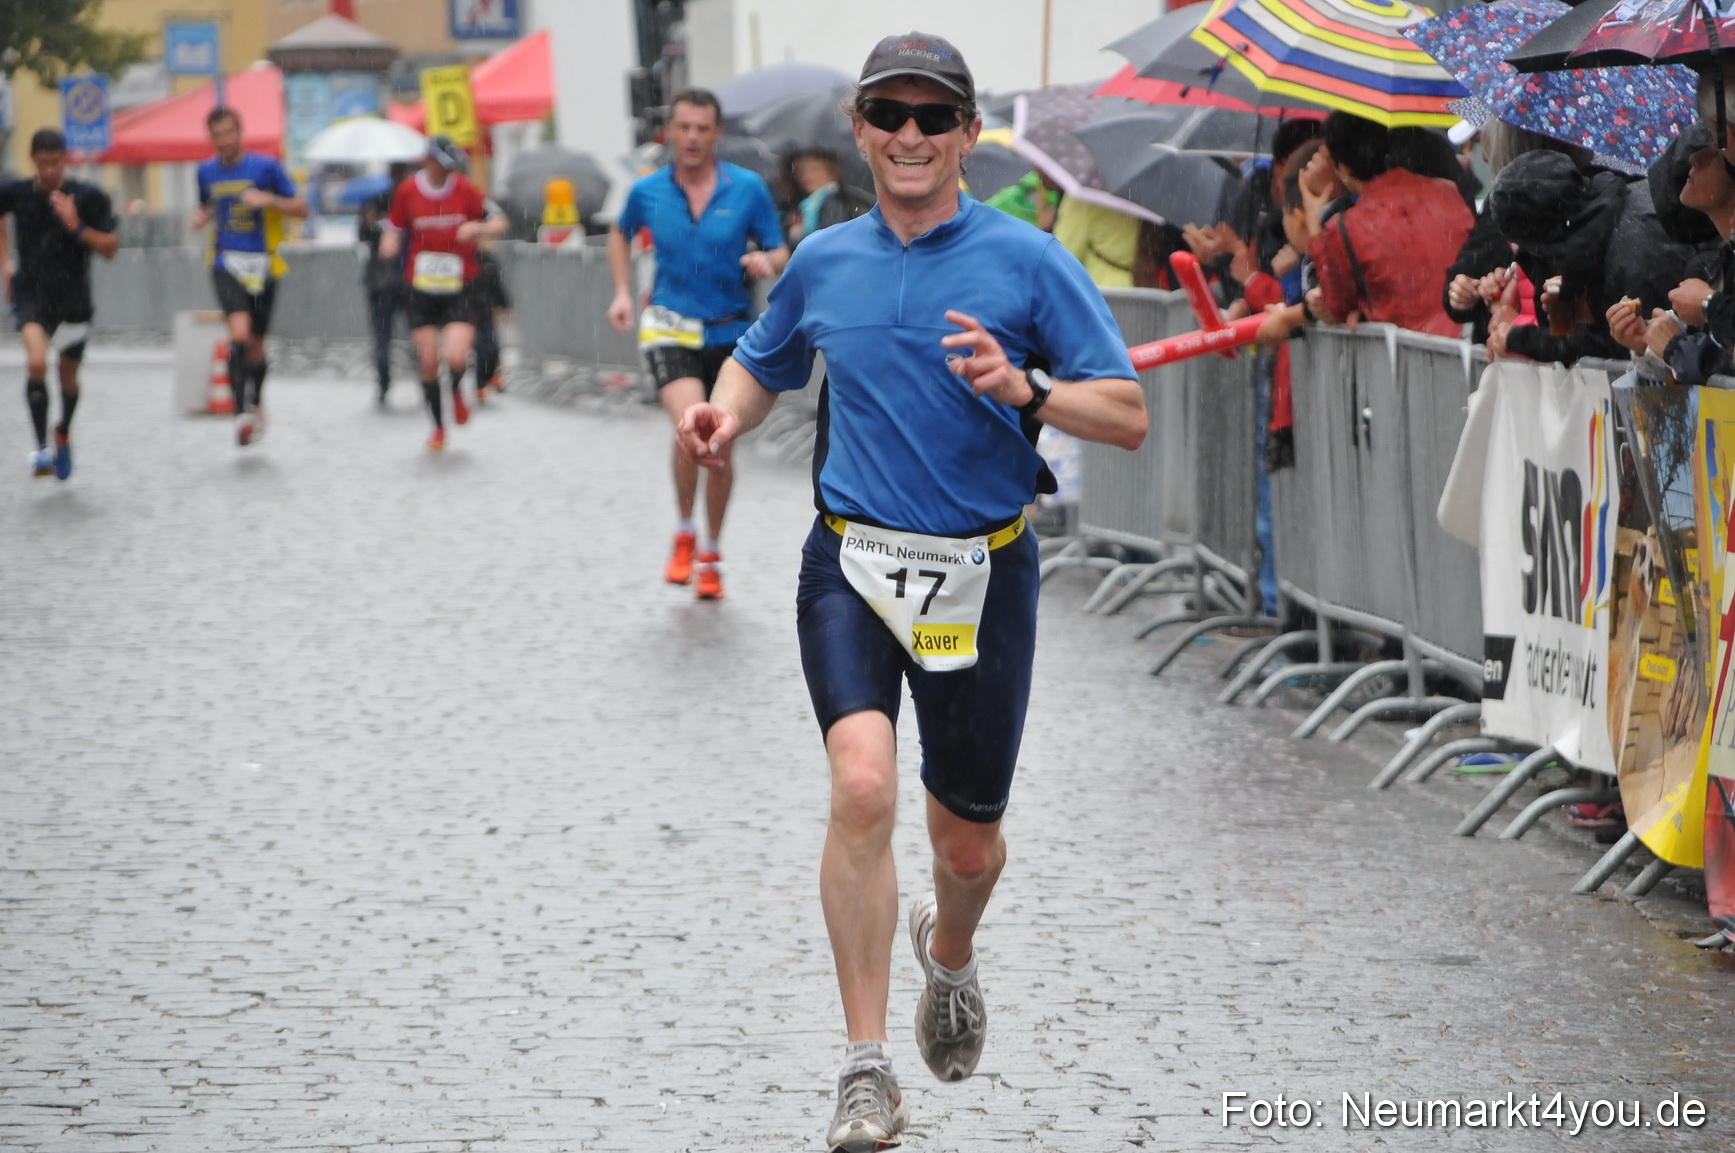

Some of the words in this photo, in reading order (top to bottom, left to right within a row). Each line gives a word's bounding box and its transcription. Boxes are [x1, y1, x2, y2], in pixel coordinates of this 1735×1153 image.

[898, 48, 941, 62] HACKNER
[845, 537, 894, 557] PARTL
[897, 546, 967, 565] Neumarkt
[885, 567, 947, 616] 17
[912, 630, 959, 651] Xaver
